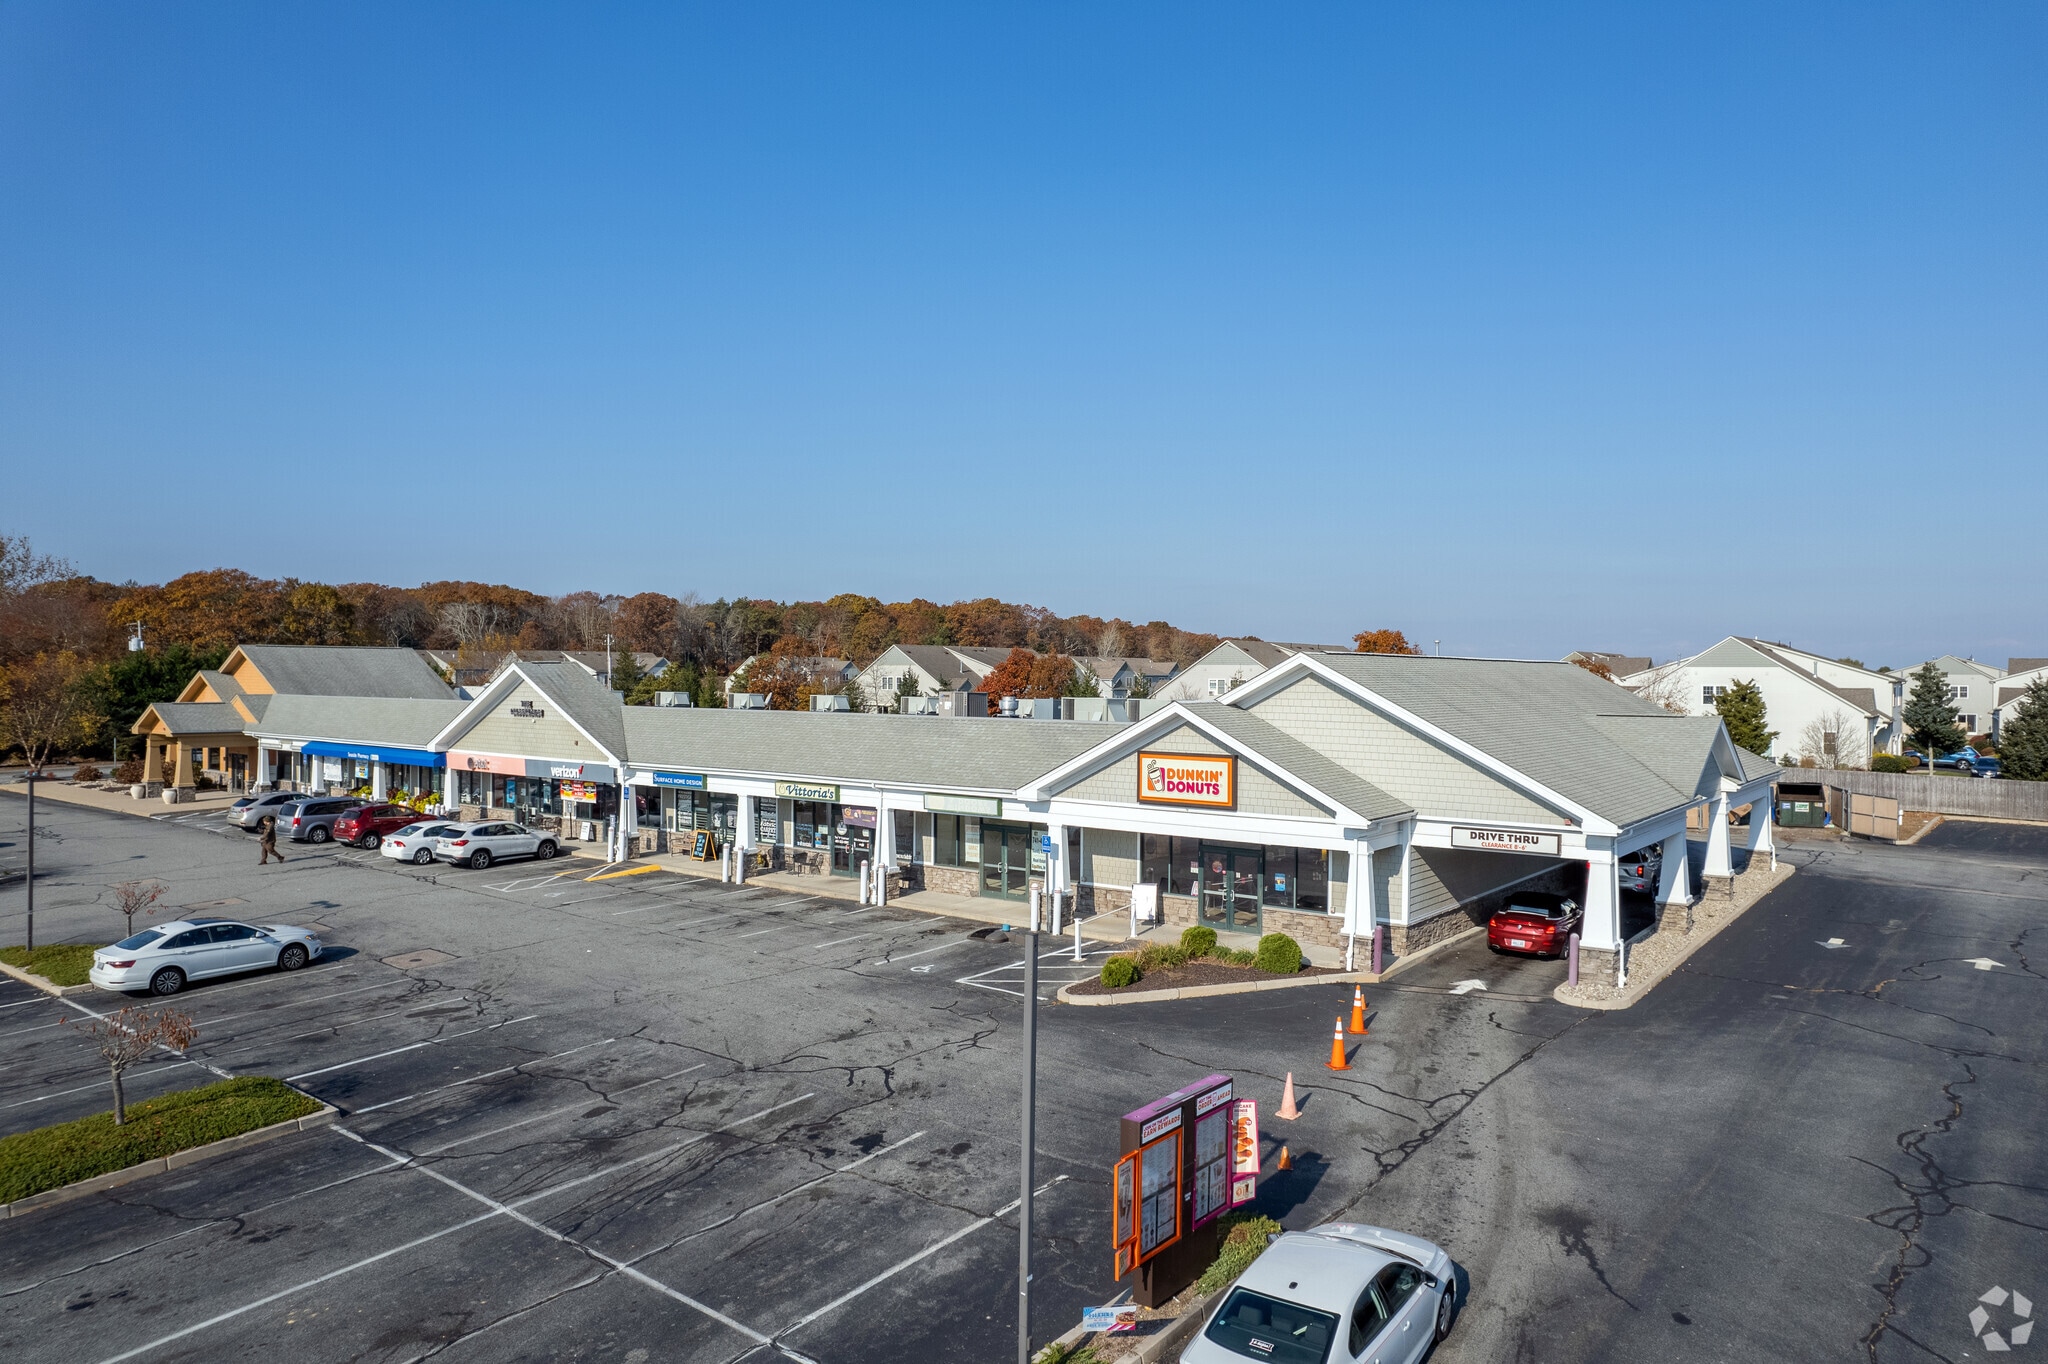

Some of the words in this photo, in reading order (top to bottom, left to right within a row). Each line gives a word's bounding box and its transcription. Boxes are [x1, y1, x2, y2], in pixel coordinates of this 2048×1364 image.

[551, 765, 580, 779] verizon
[1166, 767, 1223, 783] DUNKIN'
[785, 784, 834, 799] Vittoria's
[1166, 780, 1220, 796] DONUTS
[1469, 831, 1505, 842] DRIVE
[1506, 834, 1540, 845] THRU
[1481, 841, 1513, 849] CLEARANCE
[1198, 1100, 1212, 1110] ORDER
[1217, 1089, 1231, 1102] AHEAD
[1143, 1127, 1157, 1138] EARN
[1158, 1114, 1181, 1131] REWARDS
